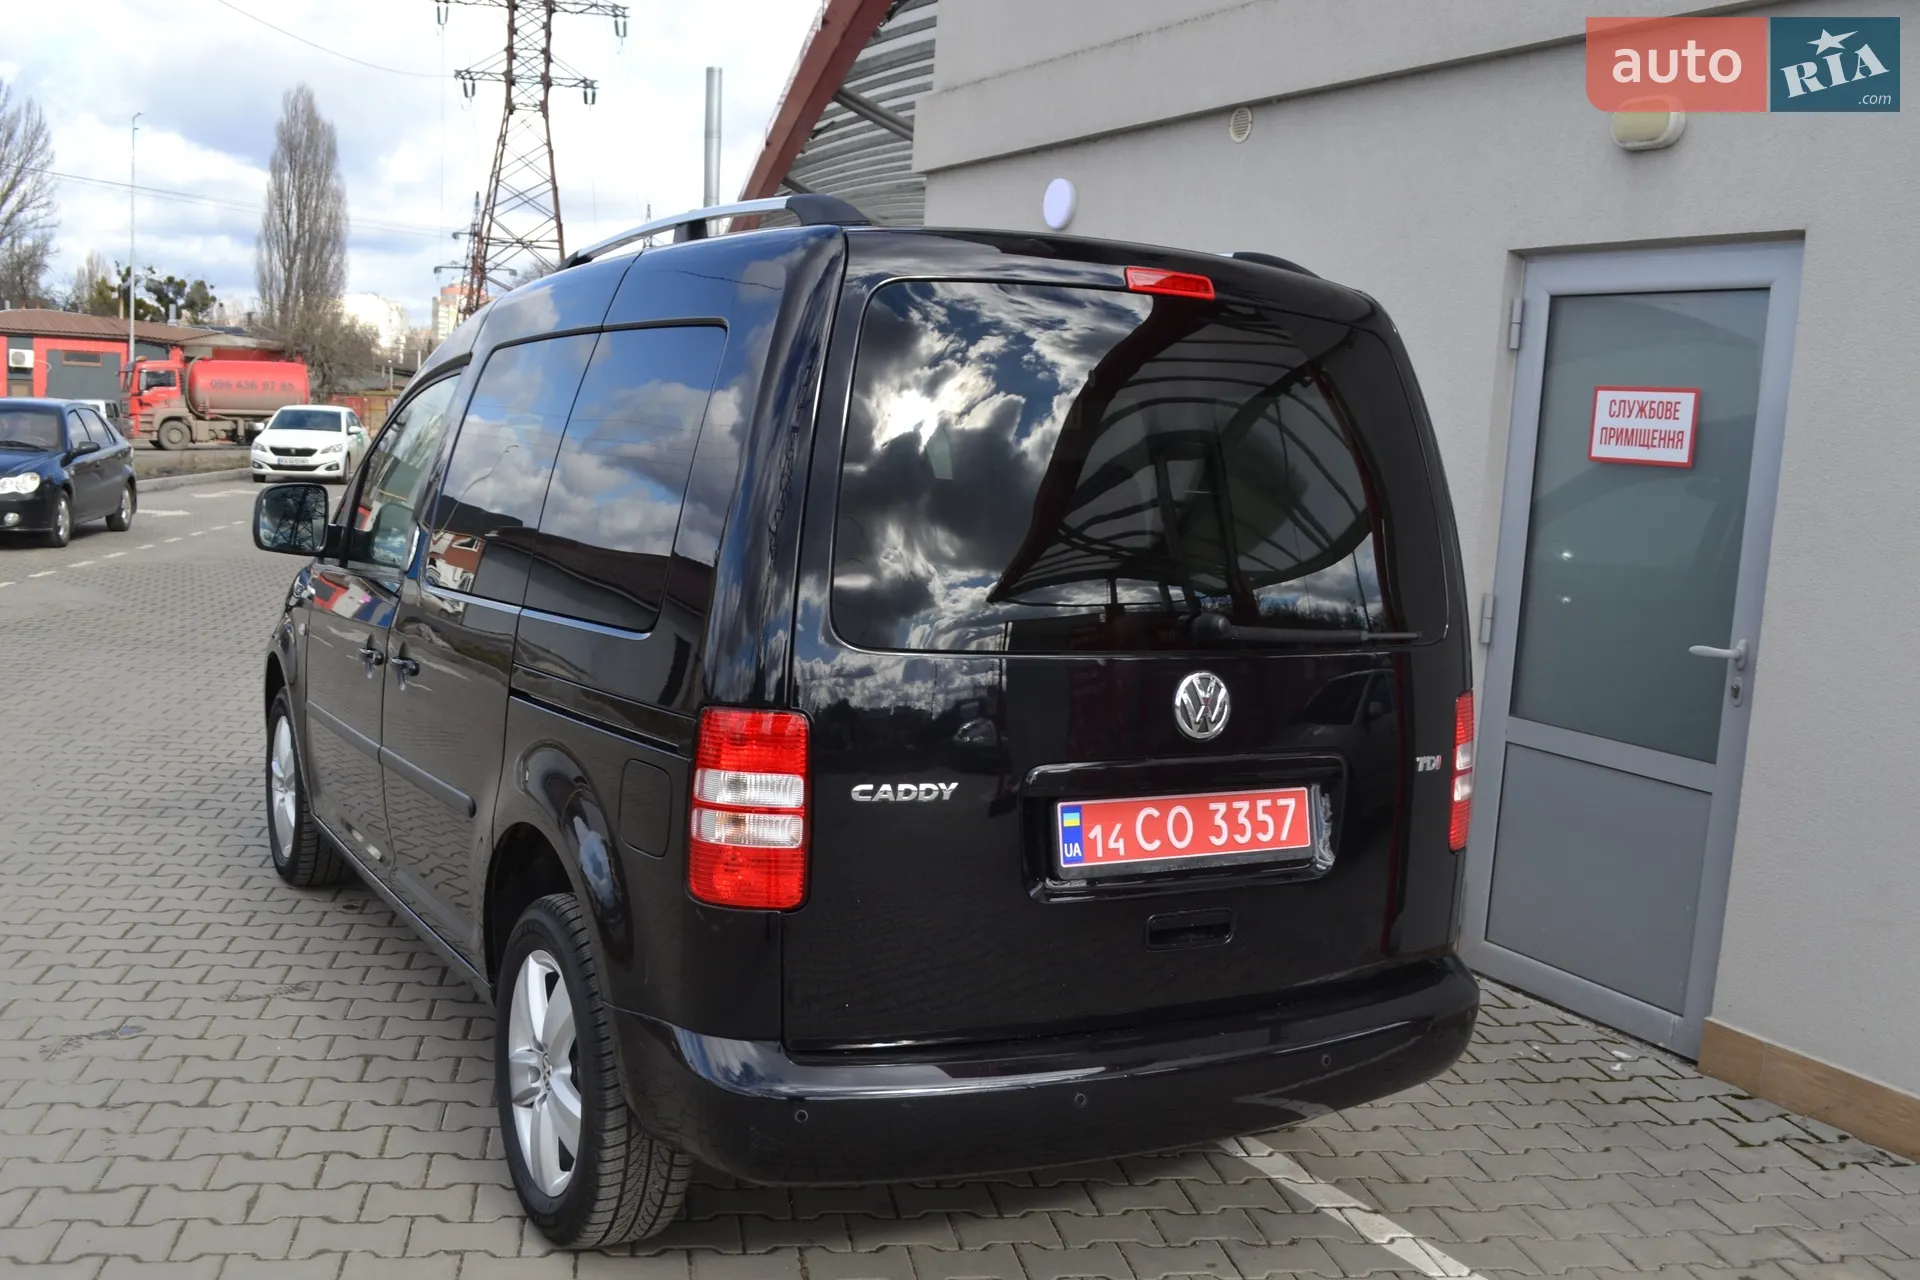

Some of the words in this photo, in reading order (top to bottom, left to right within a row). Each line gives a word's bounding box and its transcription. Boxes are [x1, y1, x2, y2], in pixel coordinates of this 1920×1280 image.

[1608, 399, 1682, 420] СЛУЖБОВЕ
[1599, 427, 1685, 449] ПРИМІЩЕННЯ
[1416, 755, 1442, 772] TDI
[851, 782, 959, 801] CADDY
[1088, 823, 1126, 857] 14
[1135, 805, 1194, 851] CO
[1208, 798, 1296, 847] 3357
[1064, 842, 1083, 858] UA
